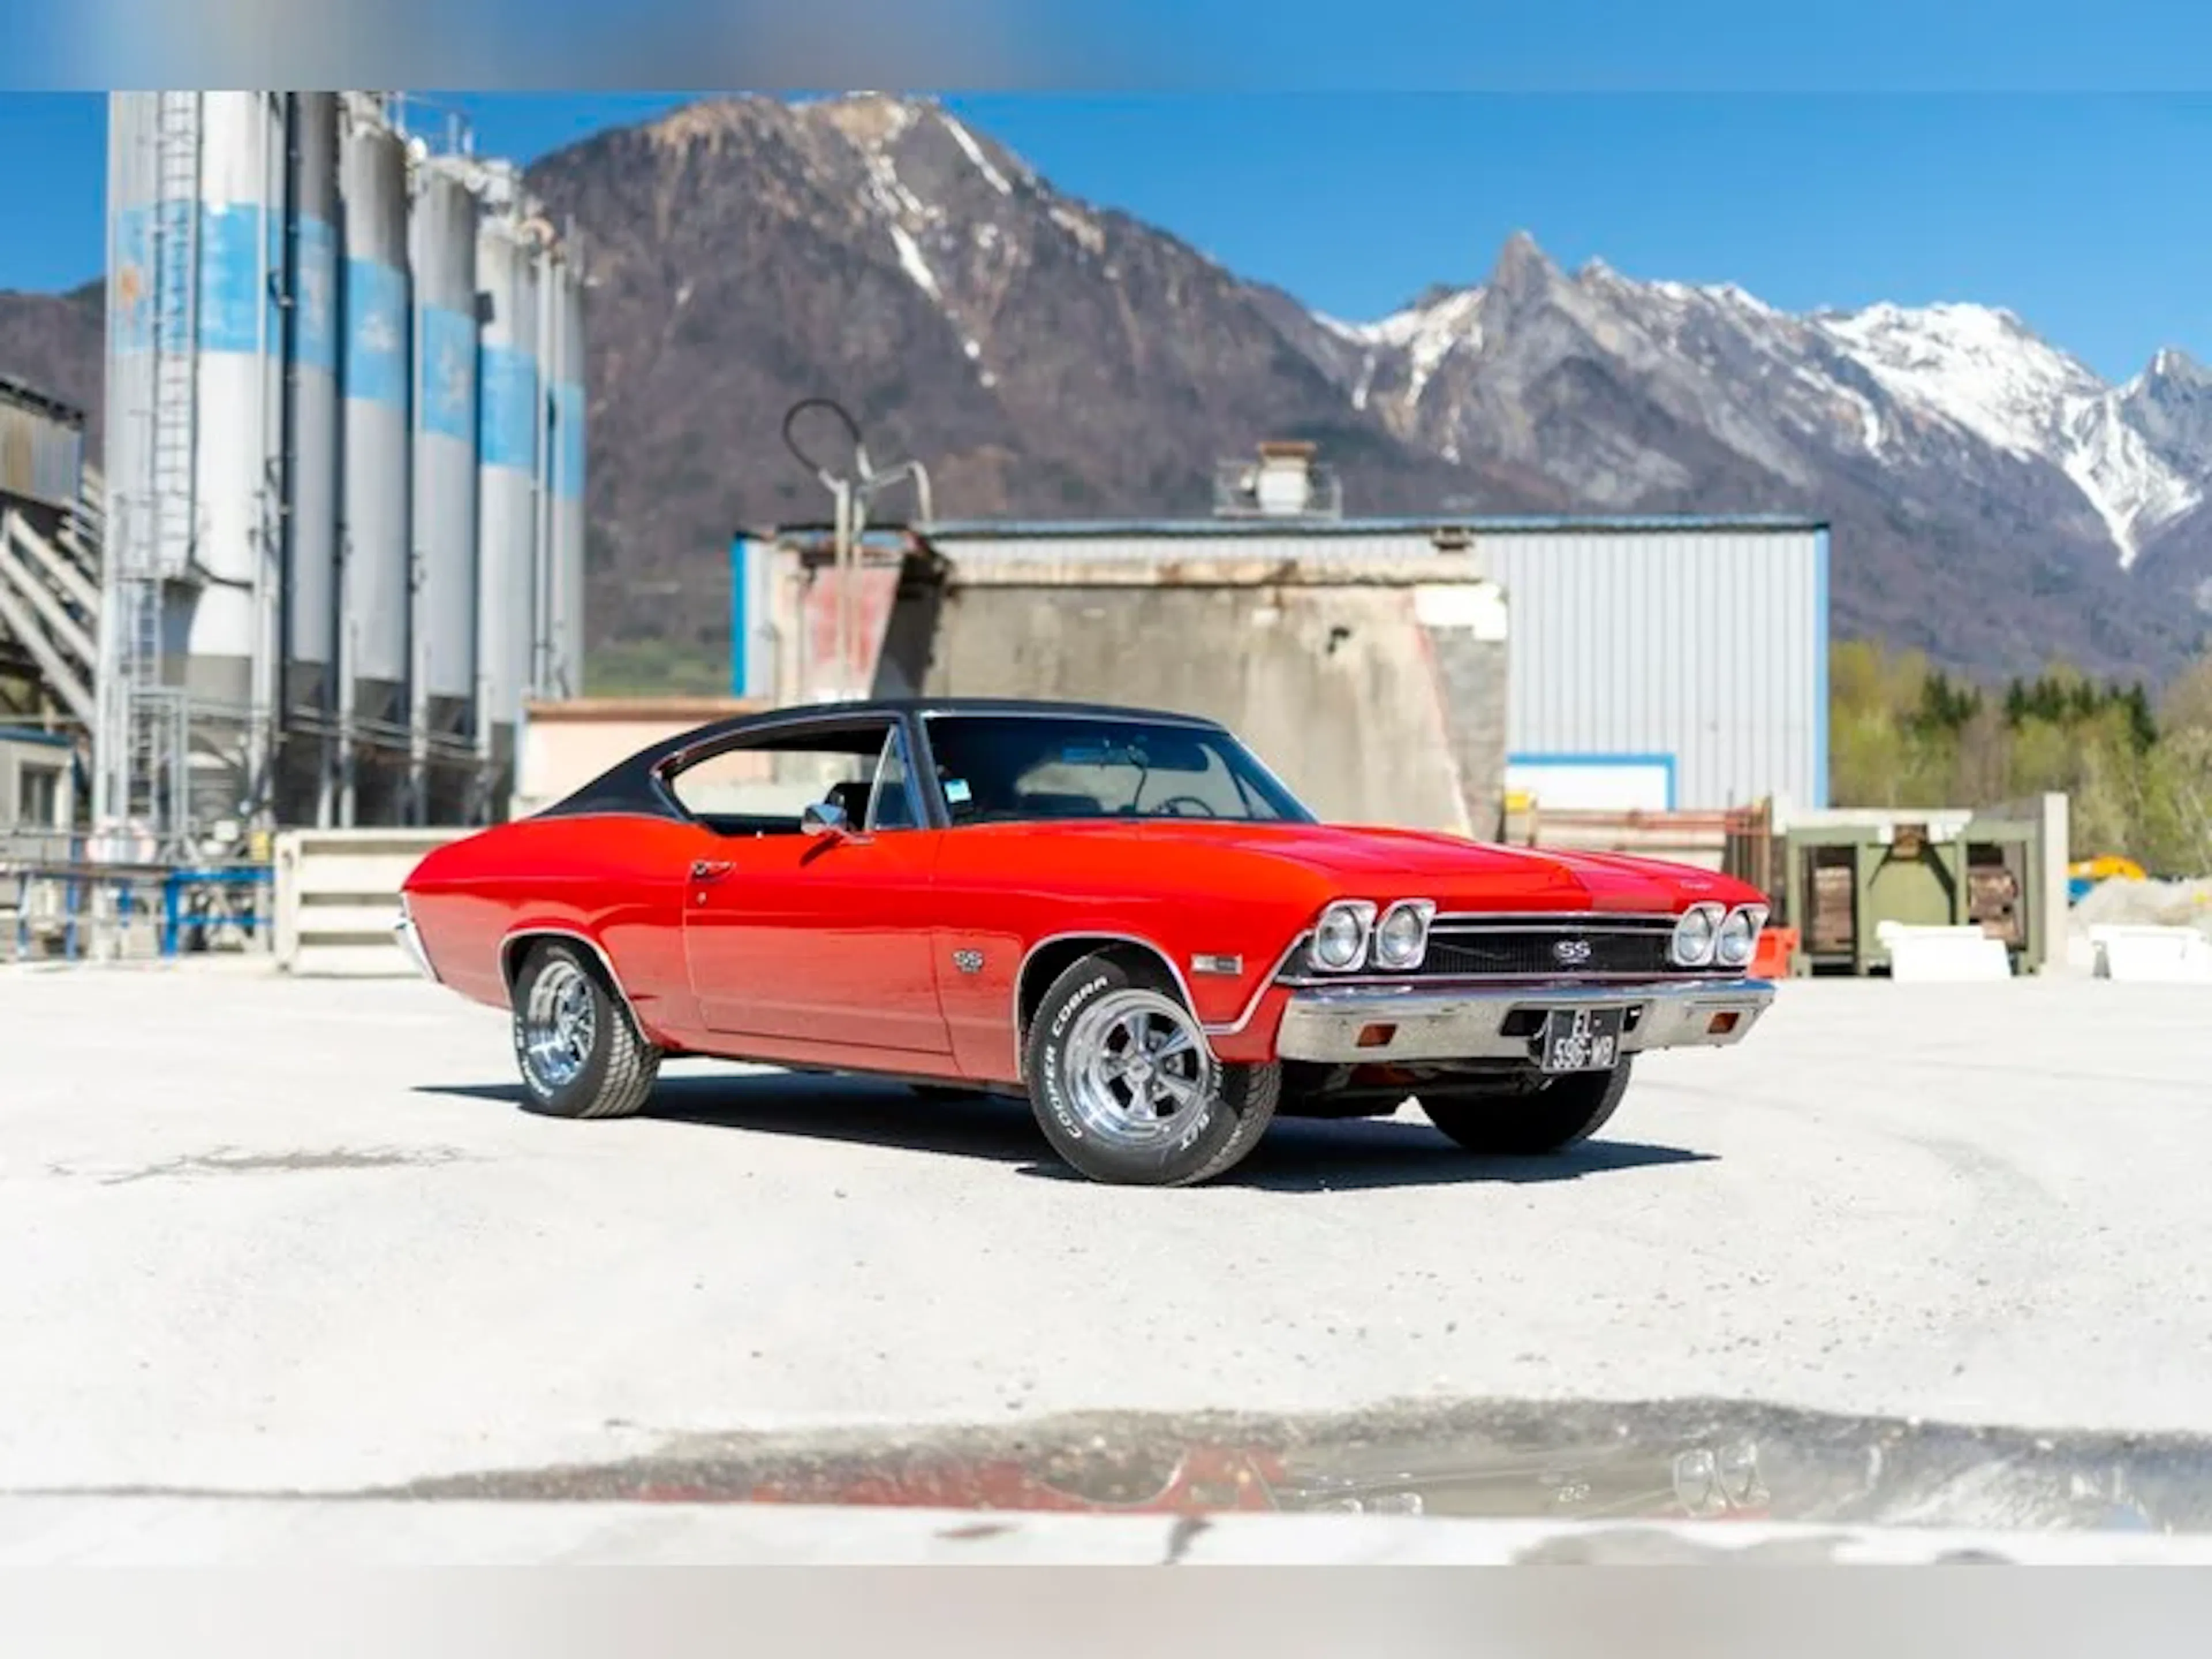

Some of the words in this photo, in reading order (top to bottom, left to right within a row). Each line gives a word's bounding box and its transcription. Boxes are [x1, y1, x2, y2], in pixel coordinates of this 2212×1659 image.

[1557, 940, 1591, 958] SS
[1052, 975, 1108, 1037] COBRA
[1044, 1044, 1083, 1138] COOPER
